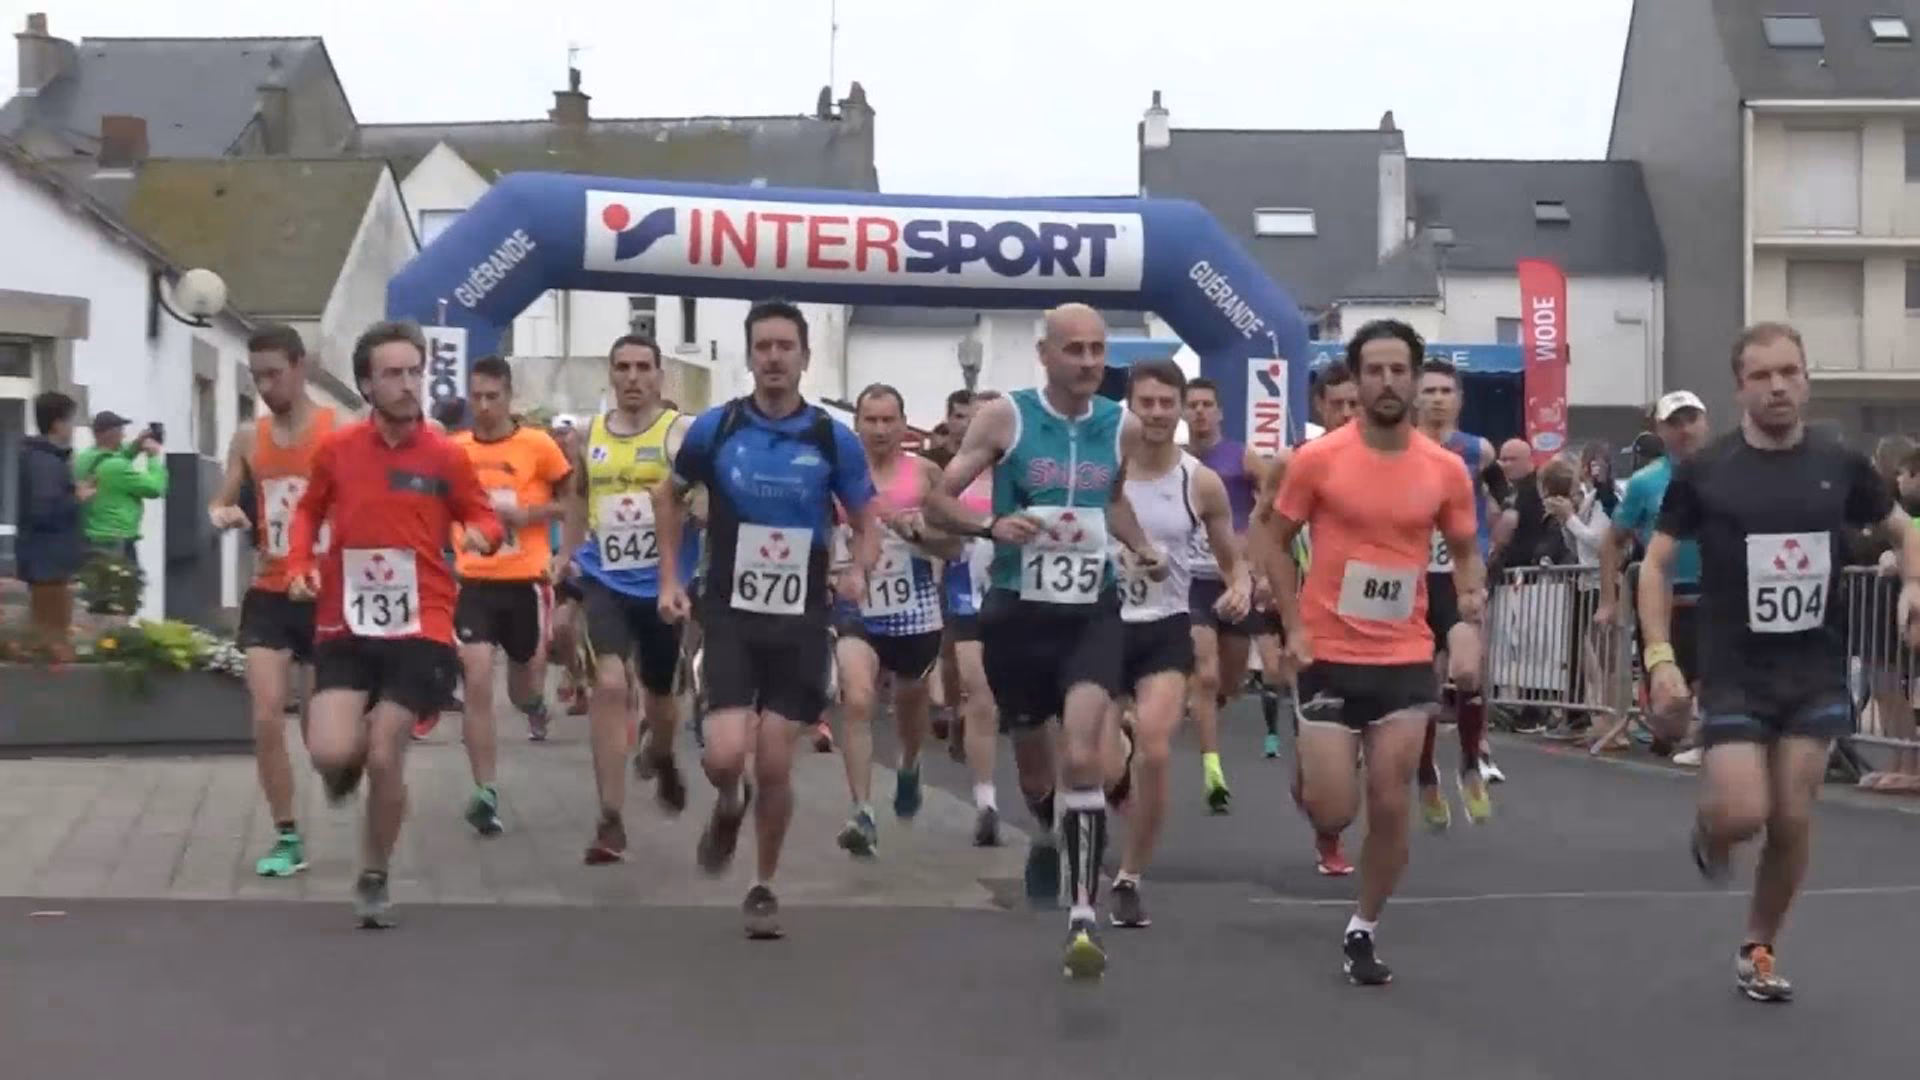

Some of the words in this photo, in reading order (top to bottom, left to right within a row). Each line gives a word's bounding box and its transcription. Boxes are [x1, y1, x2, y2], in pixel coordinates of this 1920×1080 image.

[687, 207, 1117, 278] INTERSPORT
[454, 227, 536, 308] GUÉRANDE
[1189, 260, 1265, 339] GUÉRANDE
[605, 531, 660, 563] 642
[738, 570, 802, 606] 670
[1027, 554, 1100, 593] 135
[1364, 577, 1402, 602] 842
[350, 591, 410, 627] 131
[1755, 583, 1823, 623] 504
